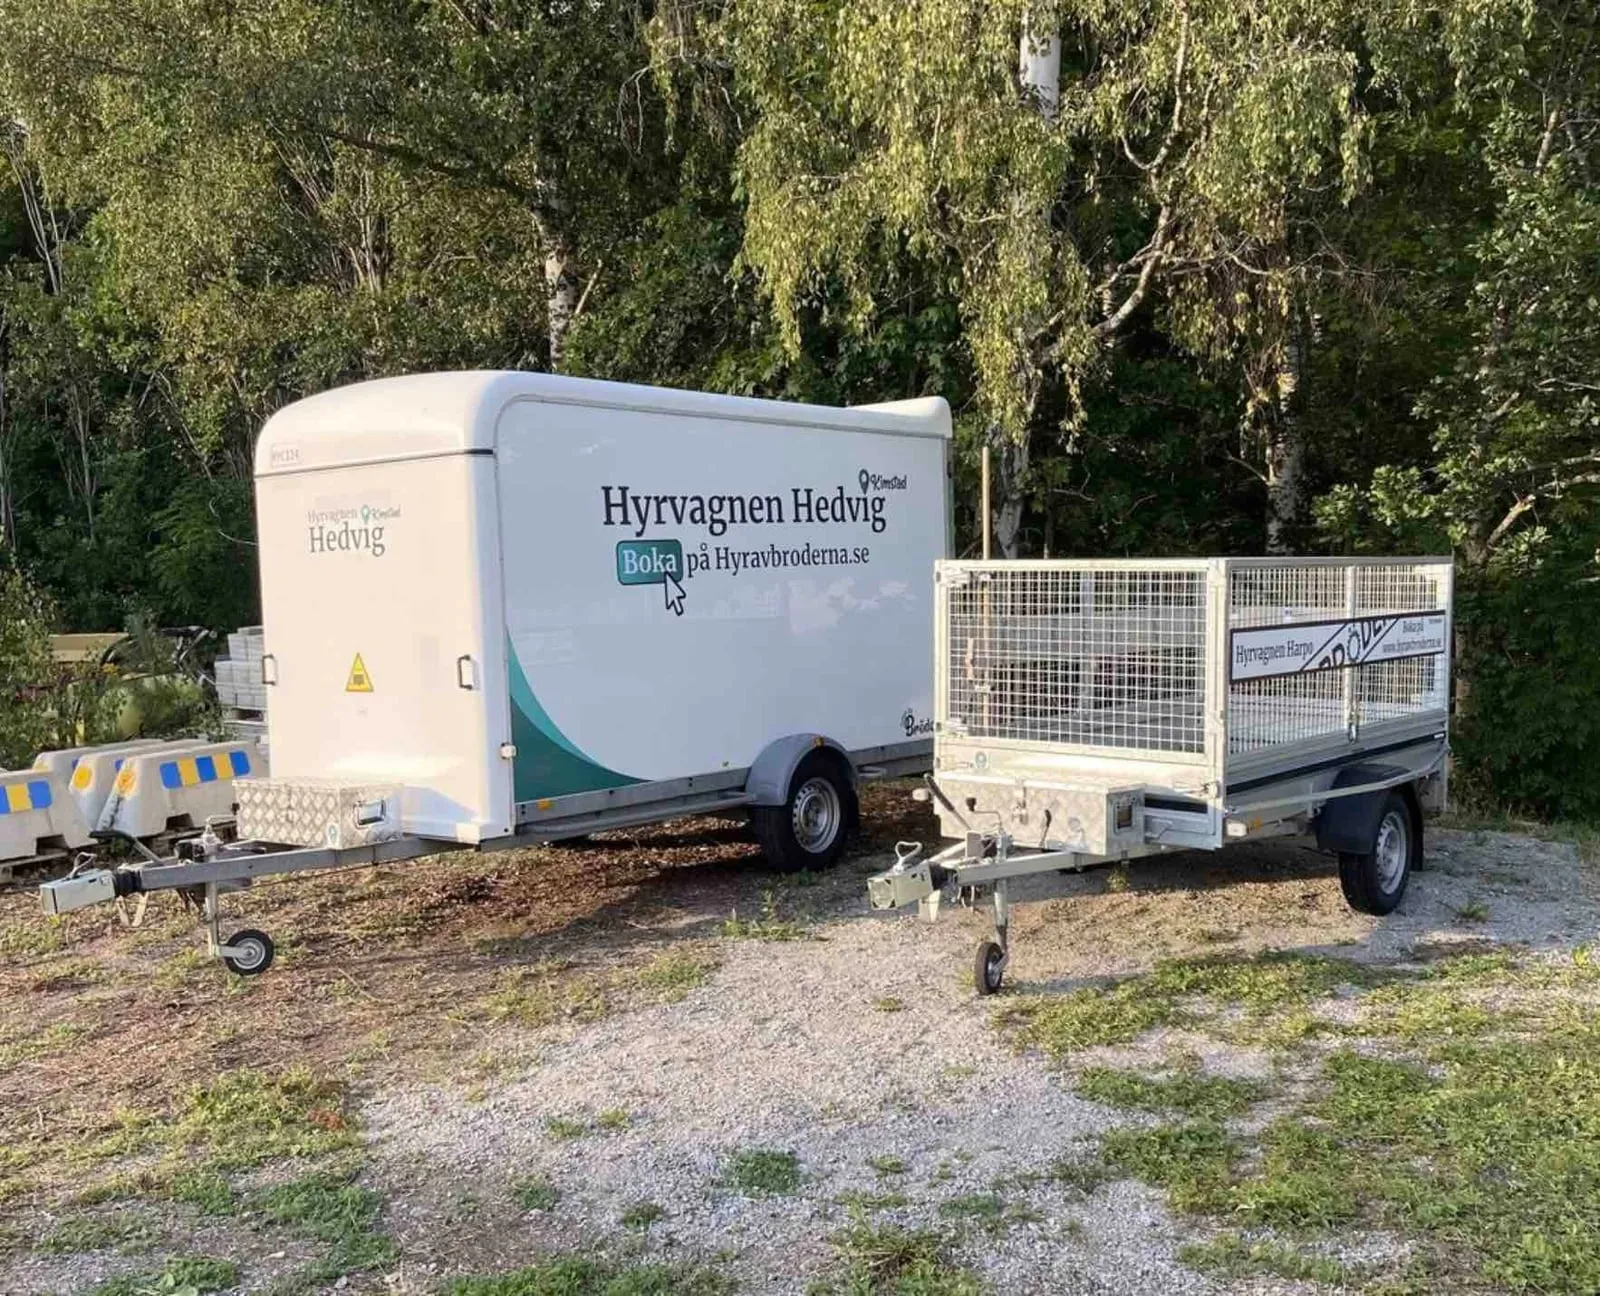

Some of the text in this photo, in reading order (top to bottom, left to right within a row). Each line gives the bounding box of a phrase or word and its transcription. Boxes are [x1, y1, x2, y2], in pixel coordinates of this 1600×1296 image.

[870, 474, 908, 491] Kimstad
[306, 507, 358, 525] Hyrvagnen
[602, 485, 887, 538] Hyrvagnen Hedvig
[309, 521, 386, 557] Hedvig
[622, 543, 870, 578] Boka på Hyravbroderna.se
[1236, 639, 1313, 668] Hyrvagnen Harpo
